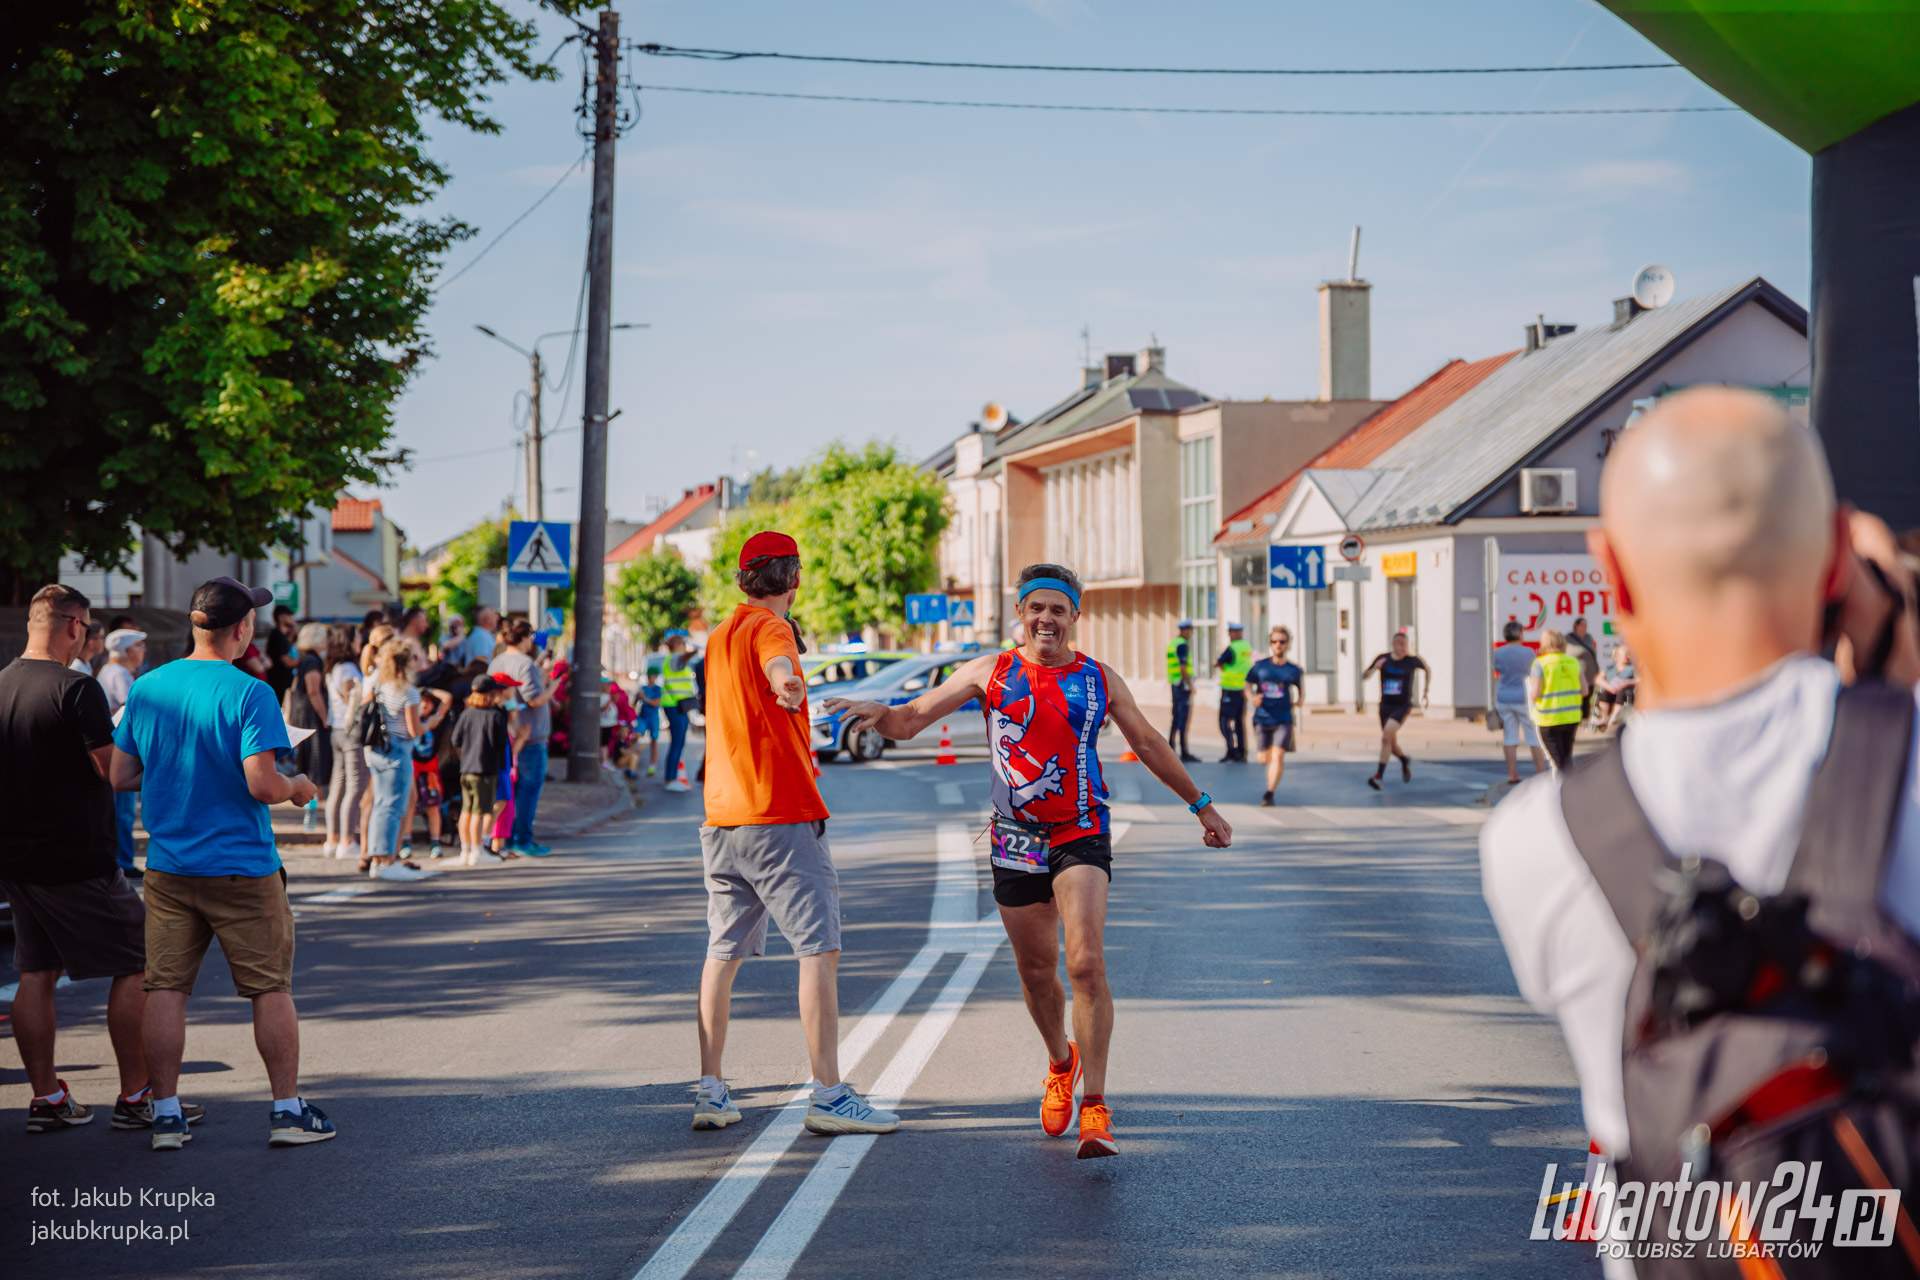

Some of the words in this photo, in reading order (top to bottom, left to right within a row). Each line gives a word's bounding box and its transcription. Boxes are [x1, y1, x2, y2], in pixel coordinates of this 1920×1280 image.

[1508, 570, 1604, 585] CAŁODO
[1555, 590, 1615, 615] APT
[1006, 833, 1030, 854] 22
